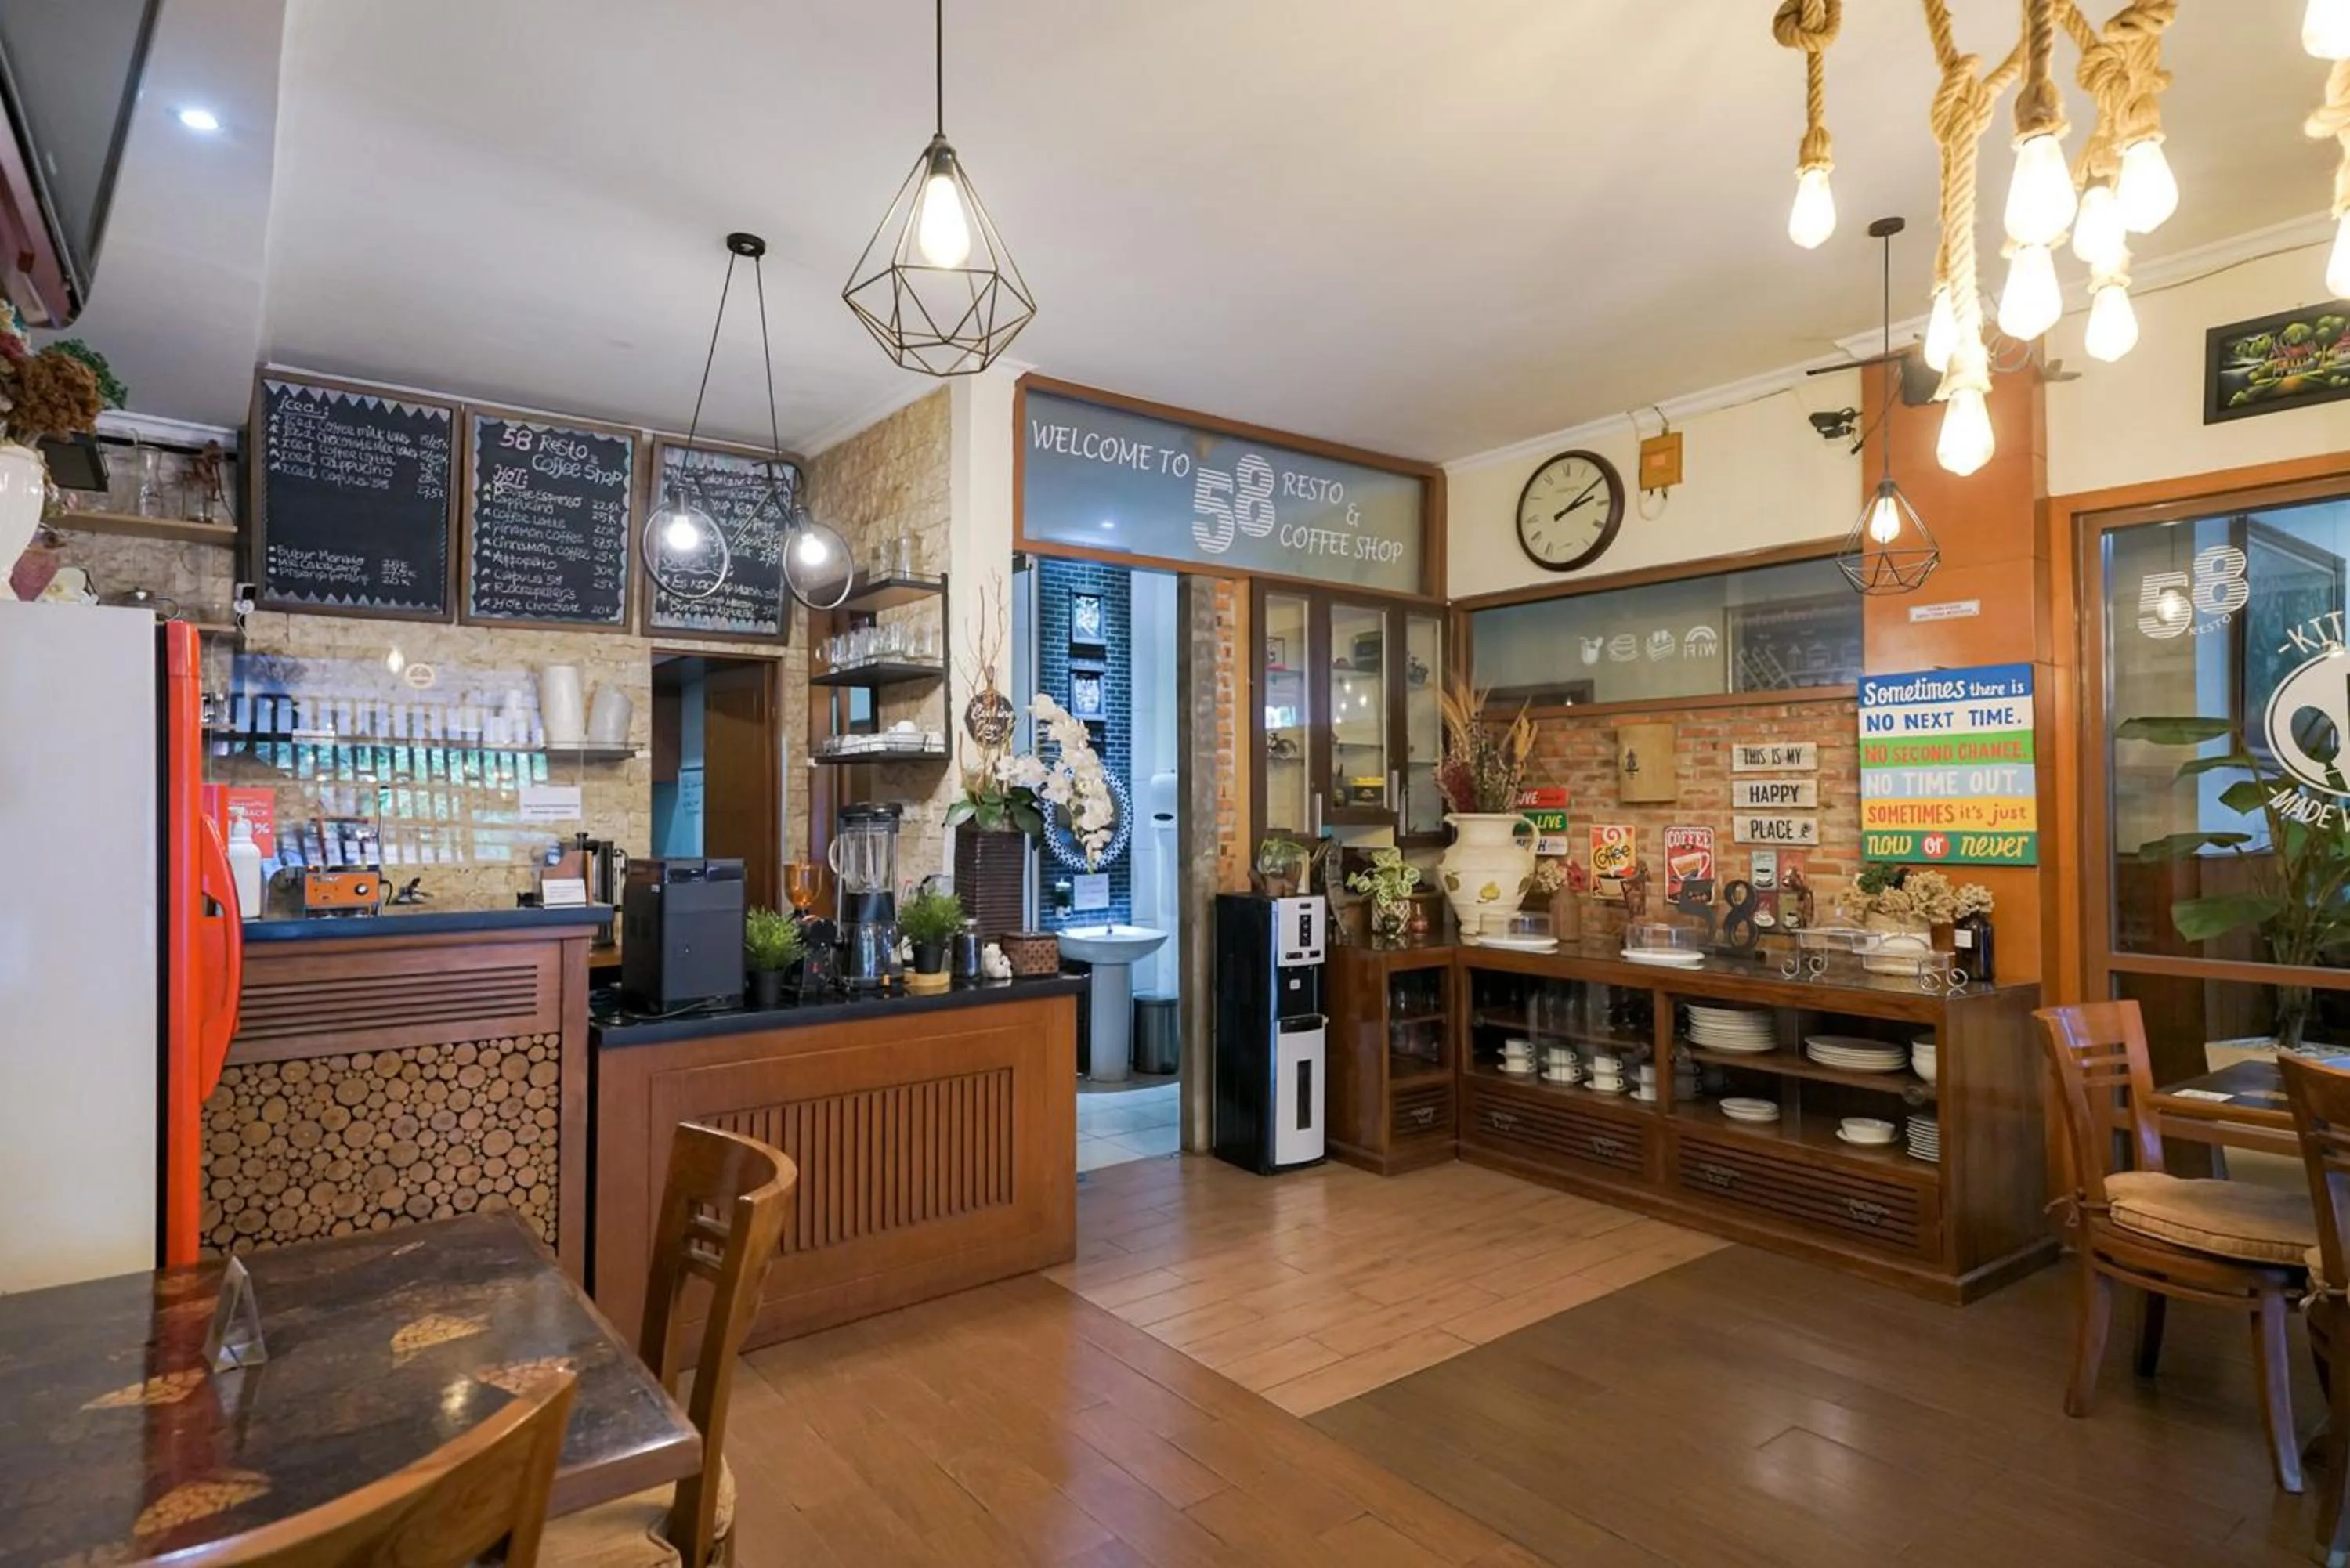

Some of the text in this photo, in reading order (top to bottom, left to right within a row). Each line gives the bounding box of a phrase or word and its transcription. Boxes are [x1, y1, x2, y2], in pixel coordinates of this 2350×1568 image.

[498, 428, 533, 451] 58
[1032, 420, 1190, 478] WELCOME TO
[532, 454, 624, 486] Coffee Shop
[1282, 471, 1343, 504] RESTO
[1191, 454, 1276, 554] 58
[1345, 502, 1360, 528] &
[1280, 524, 1404, 564] COFFEE SHOP
[2137, 545, 2250, 639] 58
[1864, 677, 2024, 705] Sometimes there is
[1867, 707, 2022, 732] NO NEXT TIME.
[1741, 747, 1802, 765] THIS IS MY
[1864, 745, 1888, 764] NO
[1893, 744, 1953, 764] SECOND
[1749, 784, 1799, 803] HAPPY
[1865, 769, 2024, 797] NO TIME OUT.
[1538, 815, 1563, 829] LIVE
[1867, 803, 2026, 827] SOMETIMES it's just
[1668, 830, 1712, 849] COFFEE
[1750, 819, 1794, 840] PLACE
[1593, 845, 1631, 870] Coffee
[1867, 835, 2029, 858] now or never
